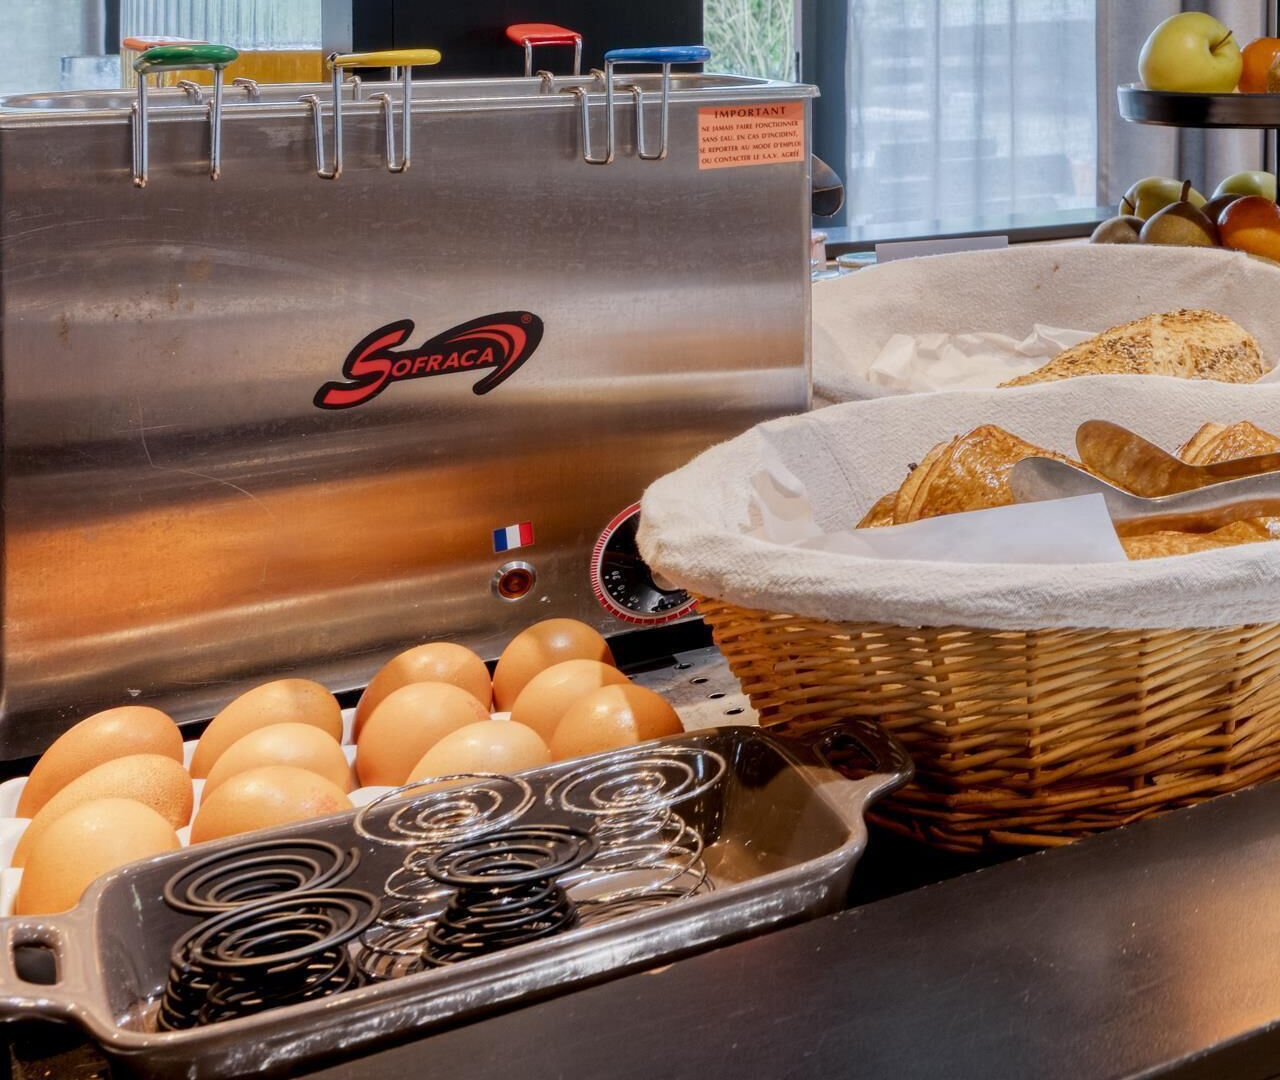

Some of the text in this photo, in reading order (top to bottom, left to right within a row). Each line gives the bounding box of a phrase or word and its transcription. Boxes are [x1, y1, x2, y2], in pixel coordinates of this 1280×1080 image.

[714, 106, 787, 119] IMPORTANT
[712, 124, 734, 132] JAMAIS
[755, 120, 799, 129] FONCTIONNER
[702, 136, 718, 144] SANS
[708, 145, 738, 153] REPORTER
[740, 143, 750, 151] AU
[752, 142, 772, 150] MODE
[701, 157, 712, 165] OU
[714, 154, 751, 163] CONTACTER
[753, 153, 761, 161] LE
[322, 329, 494, 405] SOFRACA
